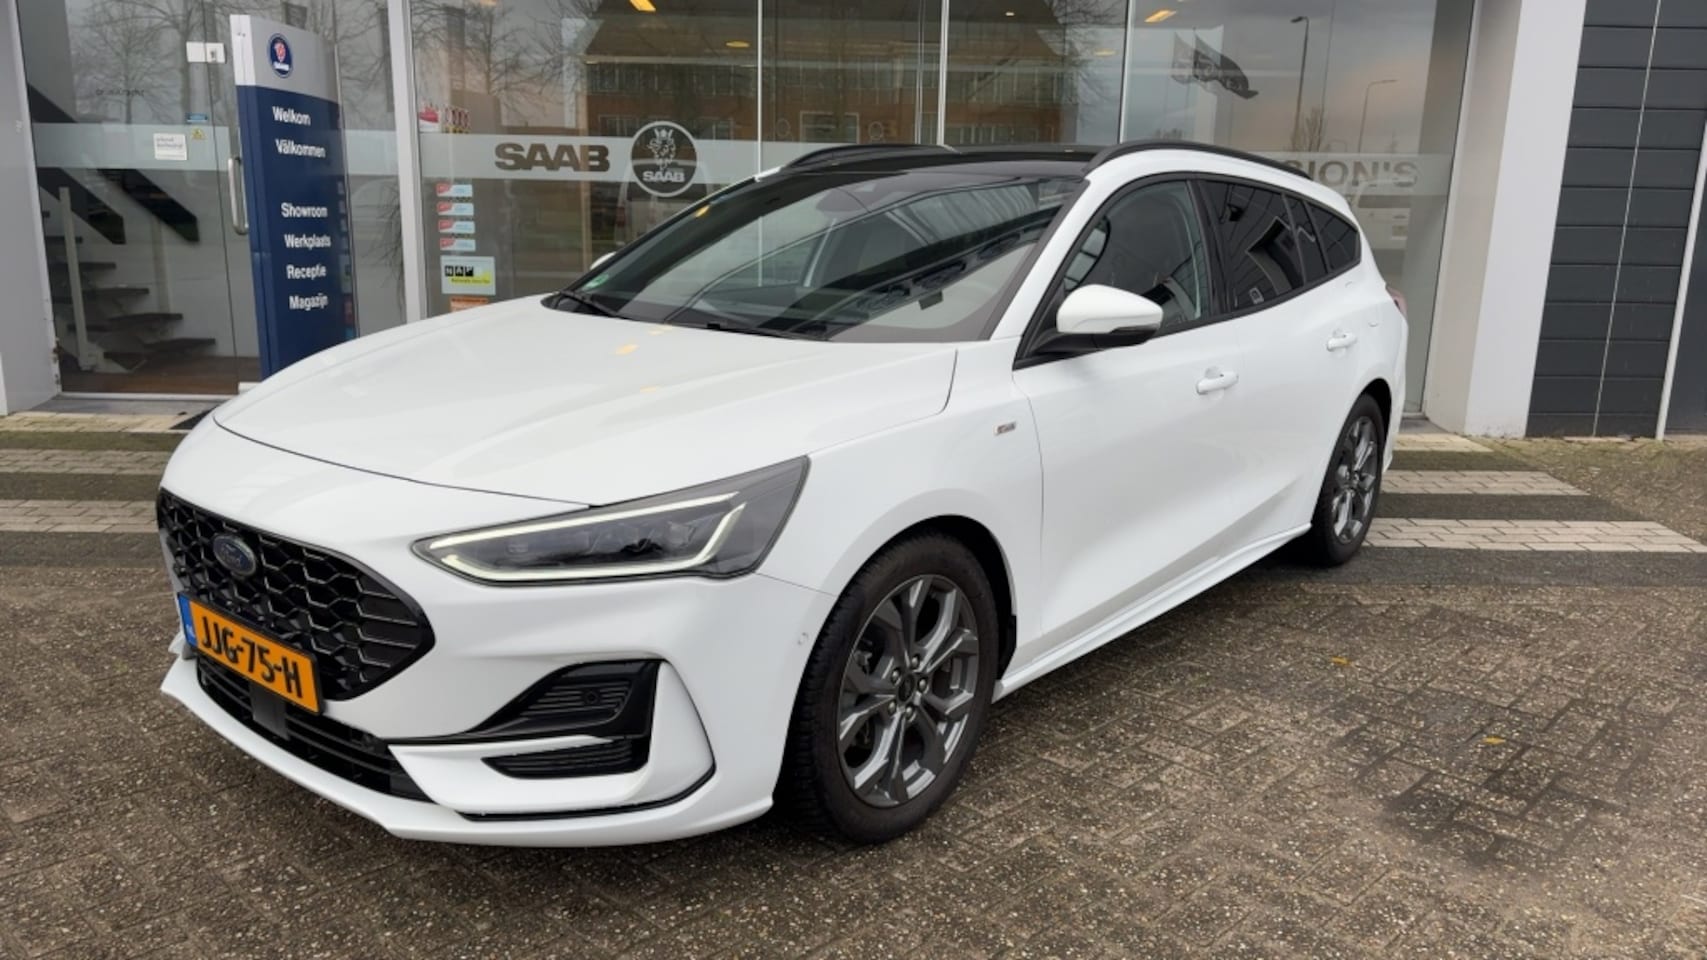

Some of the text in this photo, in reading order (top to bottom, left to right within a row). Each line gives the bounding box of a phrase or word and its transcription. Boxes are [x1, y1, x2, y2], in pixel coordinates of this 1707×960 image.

[272, 105, 311, 127] Welkom
[275, 138, 326, 158] Välkommen
[494, 142, 610, 172] SAAB
[643, 170, 685, 183] SAAB
[281, 202, 328, 218] Showroom
[284, 233, 332, 250] Werkplaats
[286, 263, 327, 280] Receptie
[289, 293, 328, 311] Magazijn
[202, 616, 303, 699] JJG-75-H
